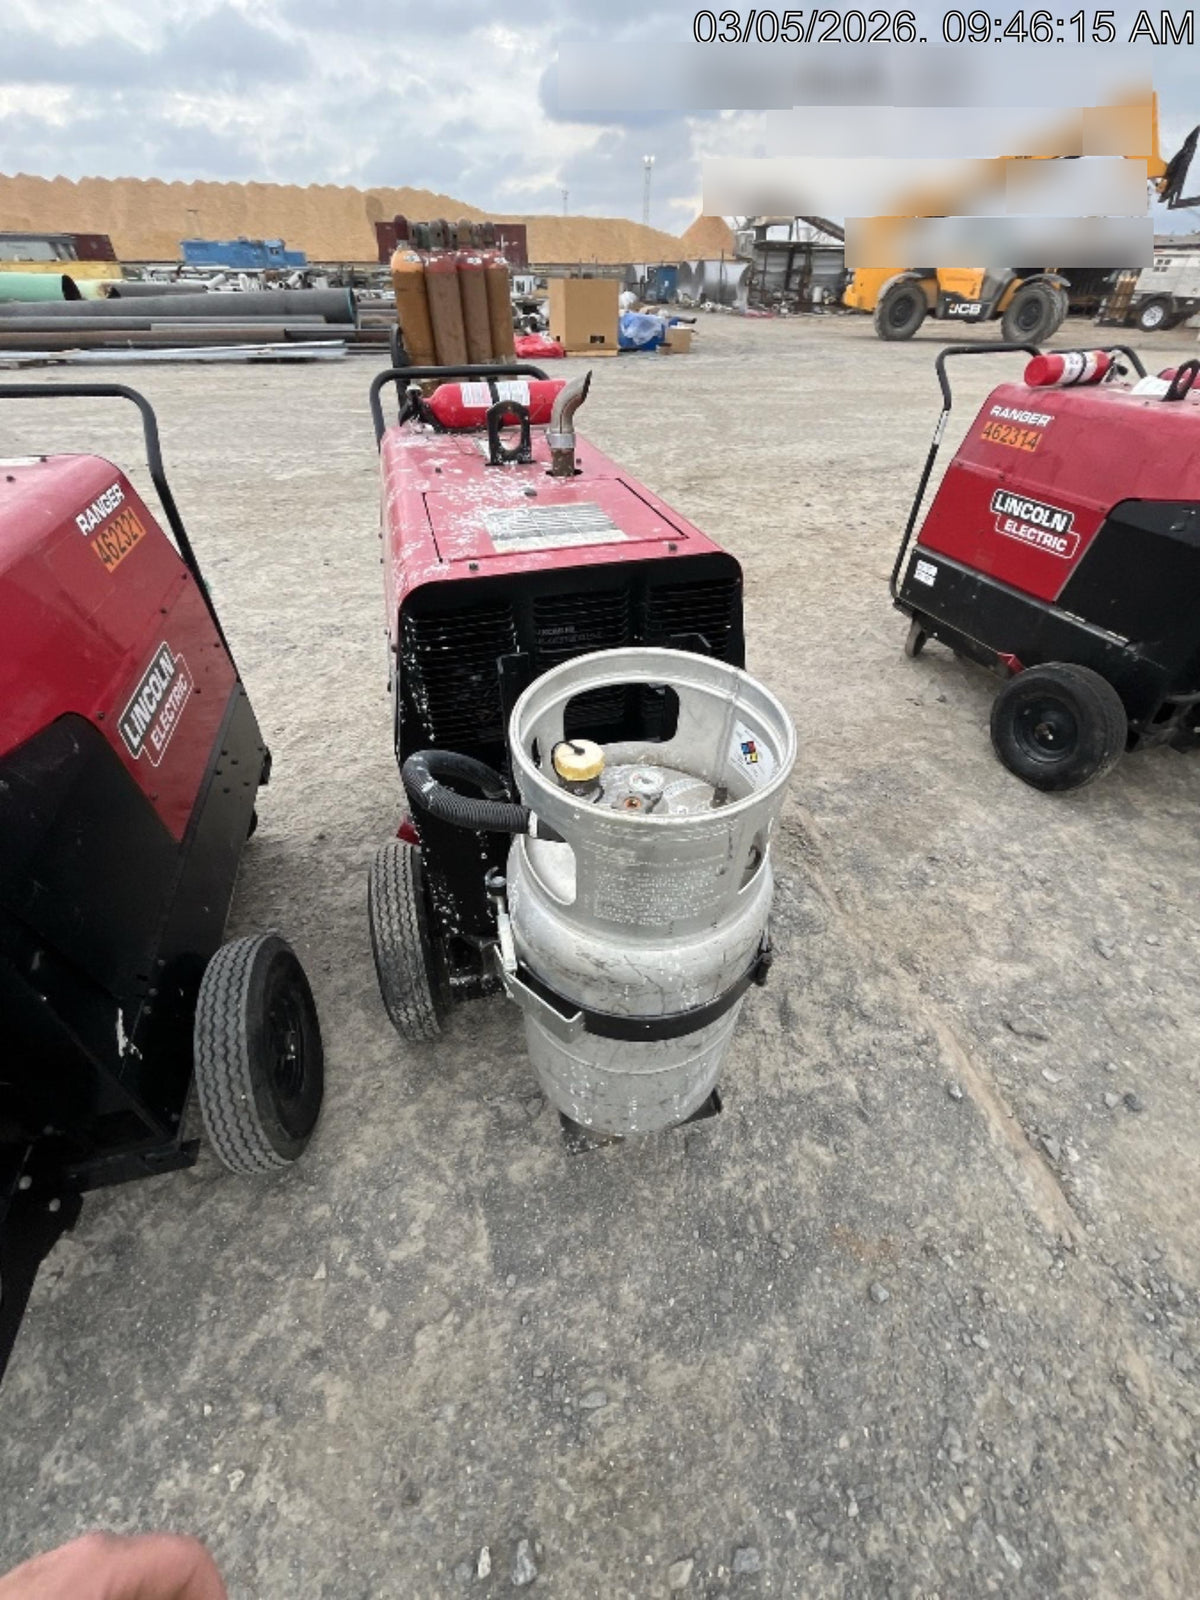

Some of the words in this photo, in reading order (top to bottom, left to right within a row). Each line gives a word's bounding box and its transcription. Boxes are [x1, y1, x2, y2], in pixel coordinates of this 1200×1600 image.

[948, 303, 982, 315] JCB
[990, 404, 1052, 428] RANGER
[983, 423, 1042, 450] 462314
[75, 482, 125, 537] RANGER
[993, 493, 1068, 532] LINCOLN
[95, 508, 143, 566] 462321
[1004, 518, 1068, 552] ELECTRIC
[124, 650, 175, 748] LINCOLN
[151, 672, 187, 751] ELECTRIC
